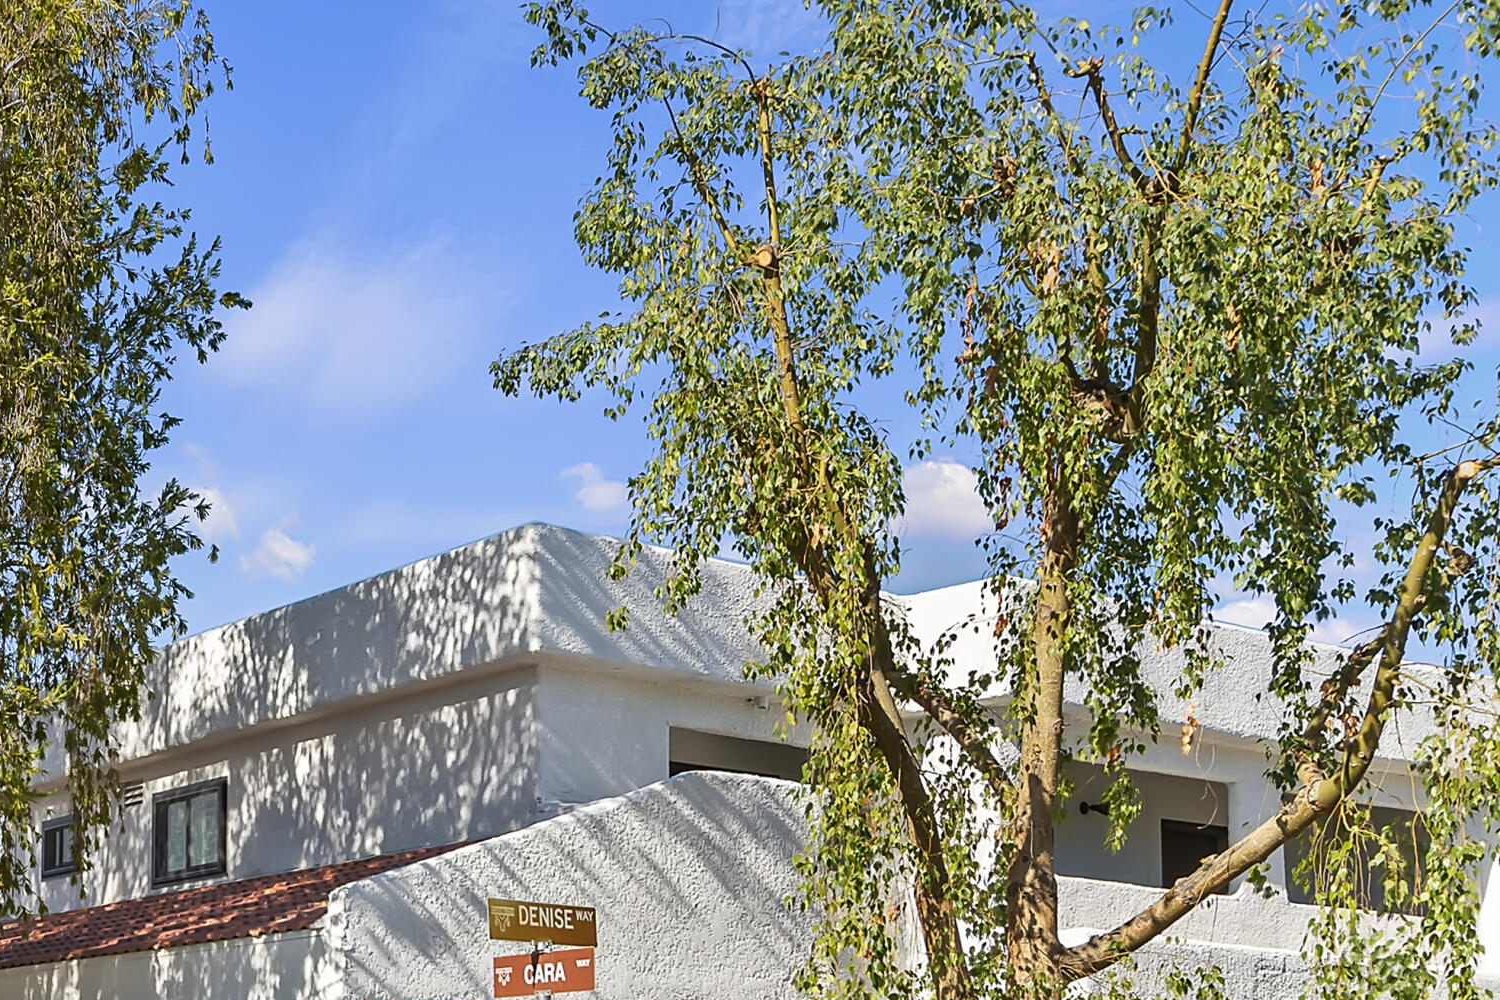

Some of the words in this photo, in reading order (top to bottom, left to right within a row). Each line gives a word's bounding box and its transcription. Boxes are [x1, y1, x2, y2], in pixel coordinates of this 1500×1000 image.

[518, 905, 574, 930] DENISE
[575, 910, 594, 922] WAY
[523, 962, 566, 985] CARA
